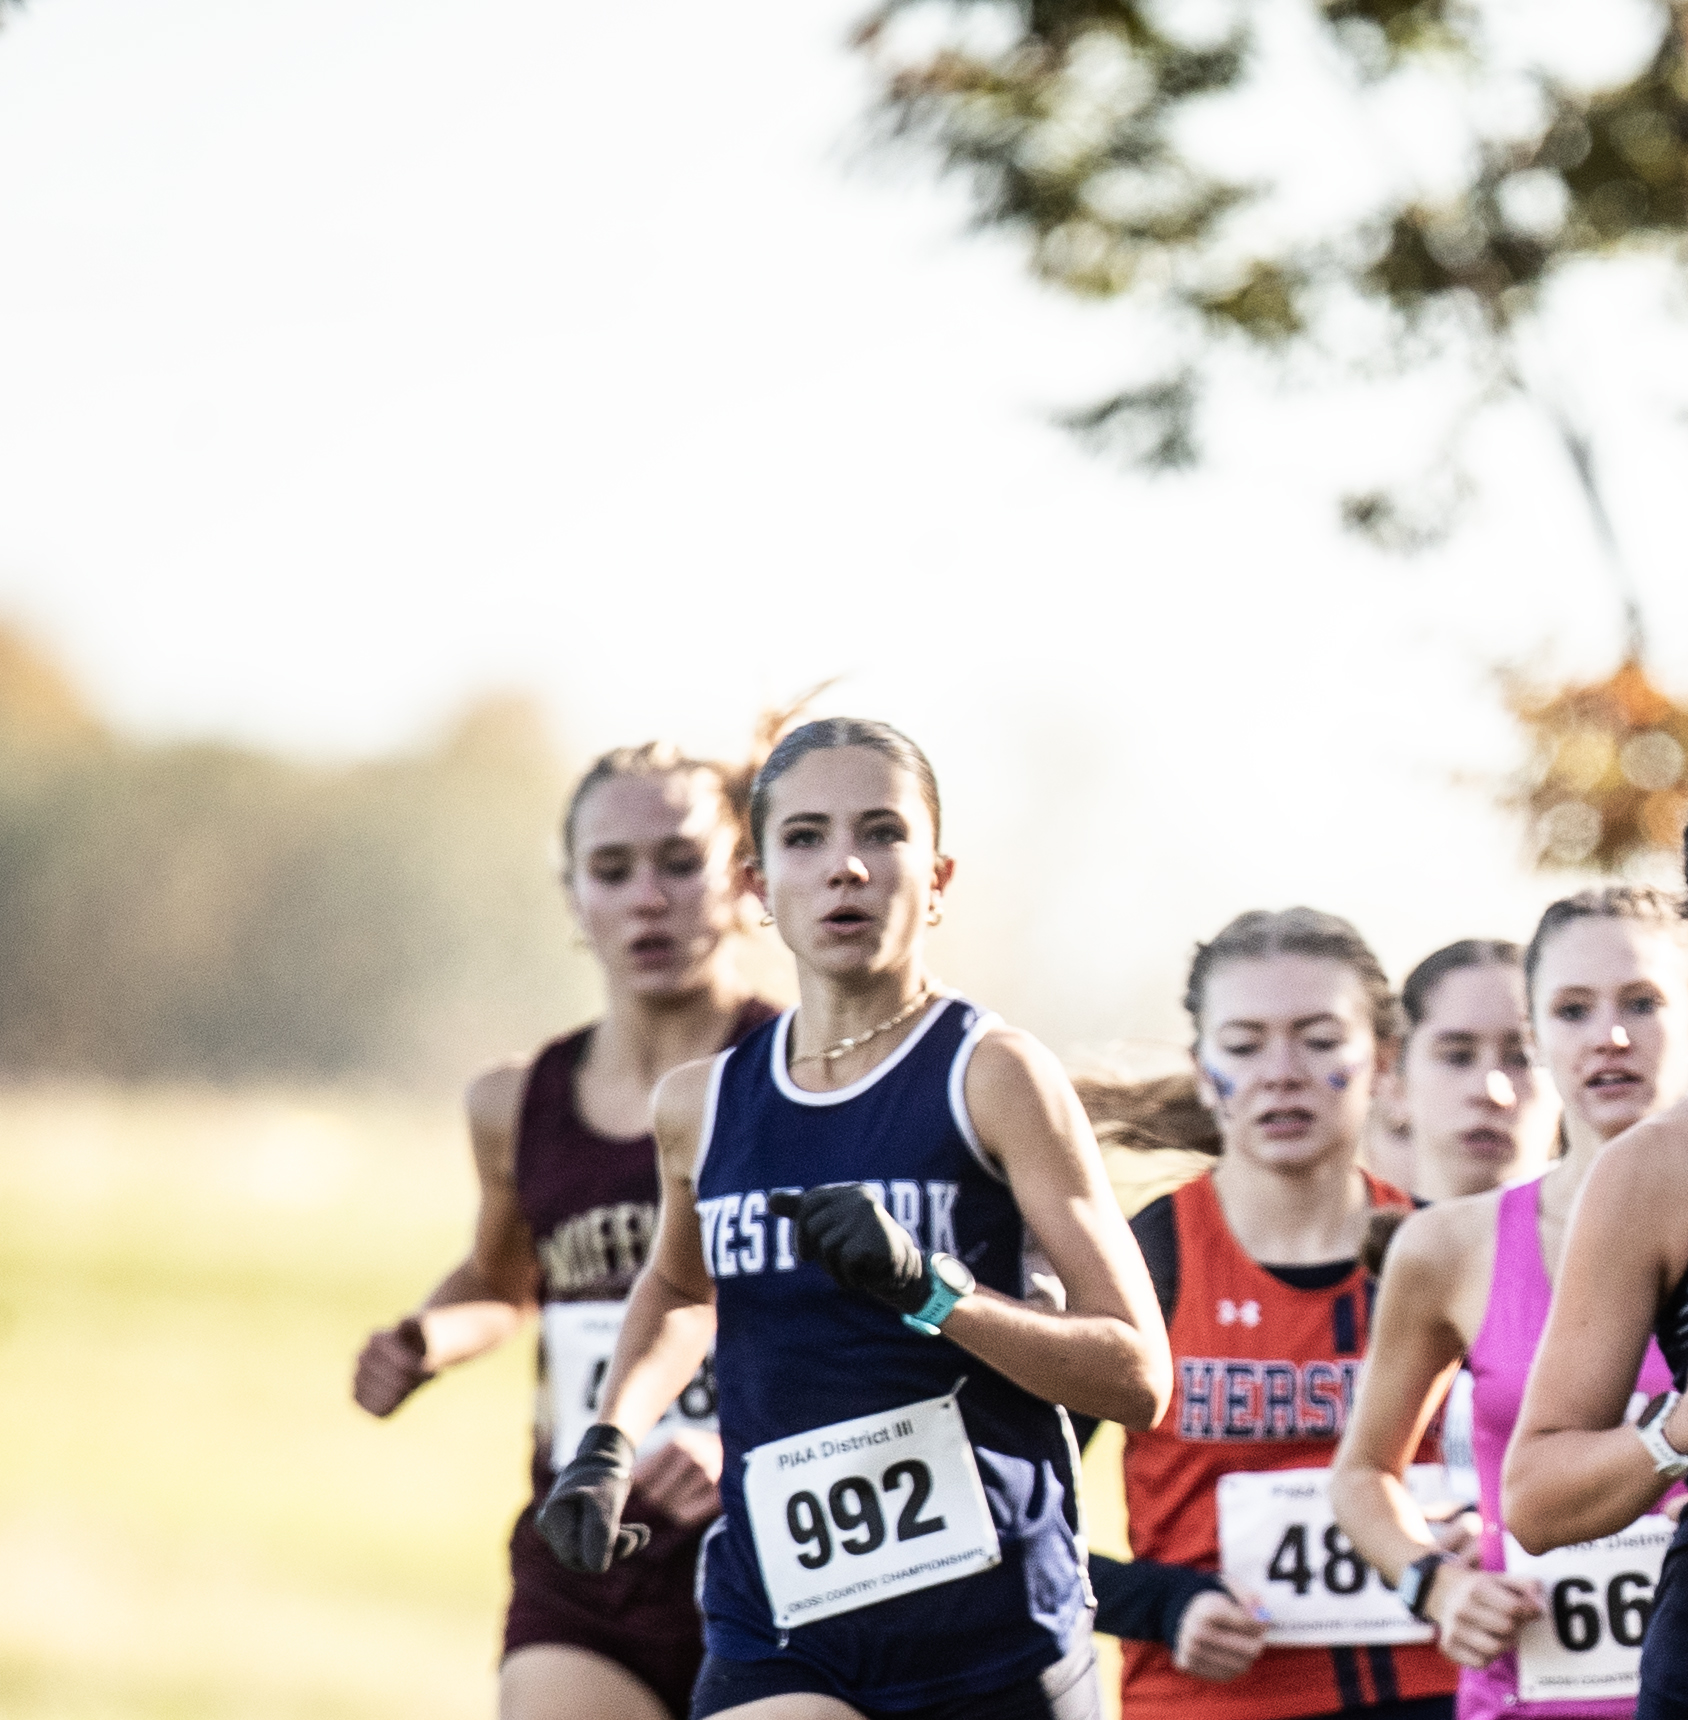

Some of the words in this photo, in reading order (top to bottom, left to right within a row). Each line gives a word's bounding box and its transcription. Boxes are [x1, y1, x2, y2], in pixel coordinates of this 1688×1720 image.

[778, 1447, 818, 1471] PIAA
[820, 1428, 890, 1457] District
[785, 1458, 948, 1570] 992
[881, 1547, 988, 1586] CHAMPIONSHIPS
[1267, 1523, 1399, 1597] 48
